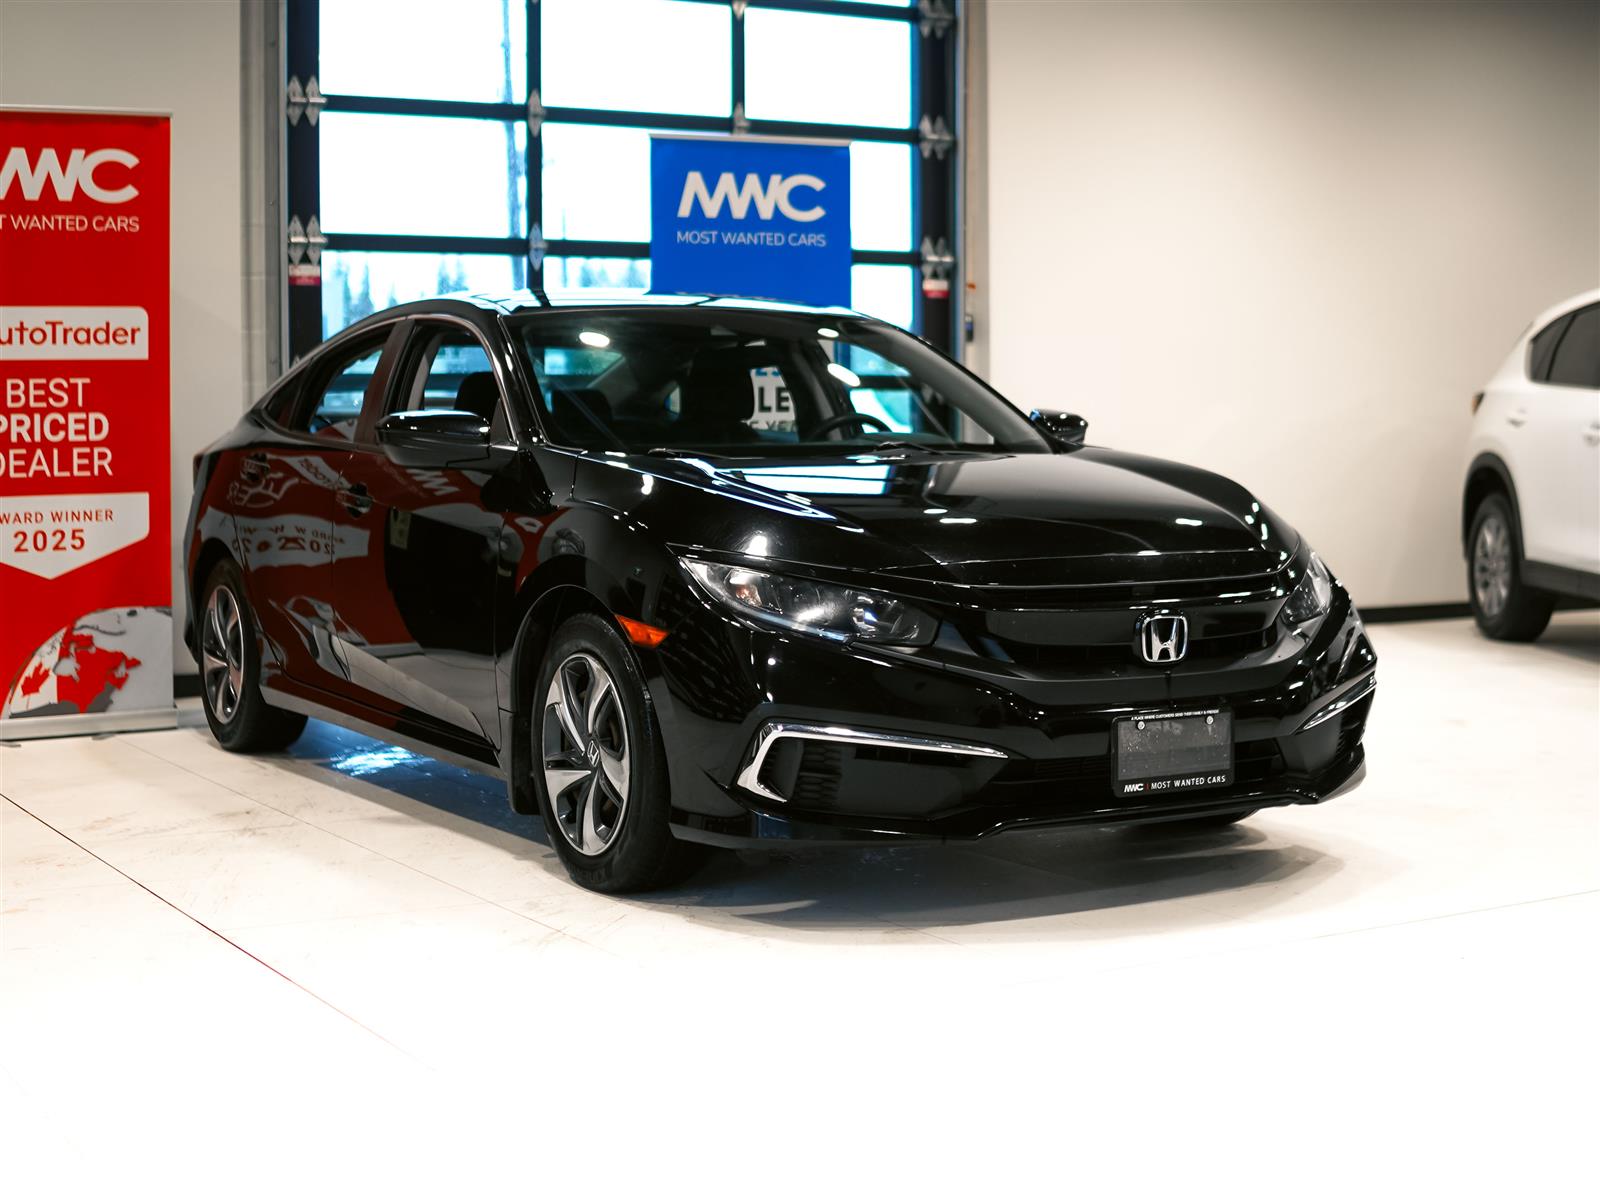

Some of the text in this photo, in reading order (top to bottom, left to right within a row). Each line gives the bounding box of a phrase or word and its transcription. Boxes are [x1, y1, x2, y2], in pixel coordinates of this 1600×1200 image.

[677, 171, 827, 222] MWC
[10, 214, 88, 232] WANTED
[92, 215, 140, 232] CARS
[676, 230, 827, 247] MOST WANTED CARS
[0, 320, 141, 346] utoTrader
[6, 377, 91, 409] BEST
[0, 508, 114, 525] WARD WINNER
[13, 528, 85, 553] 2025
[1151, 780, 1171, 790] MOST
[1174, 778, 1204, 787] WANTED
[1207, 775, 1226, 784] CARS
